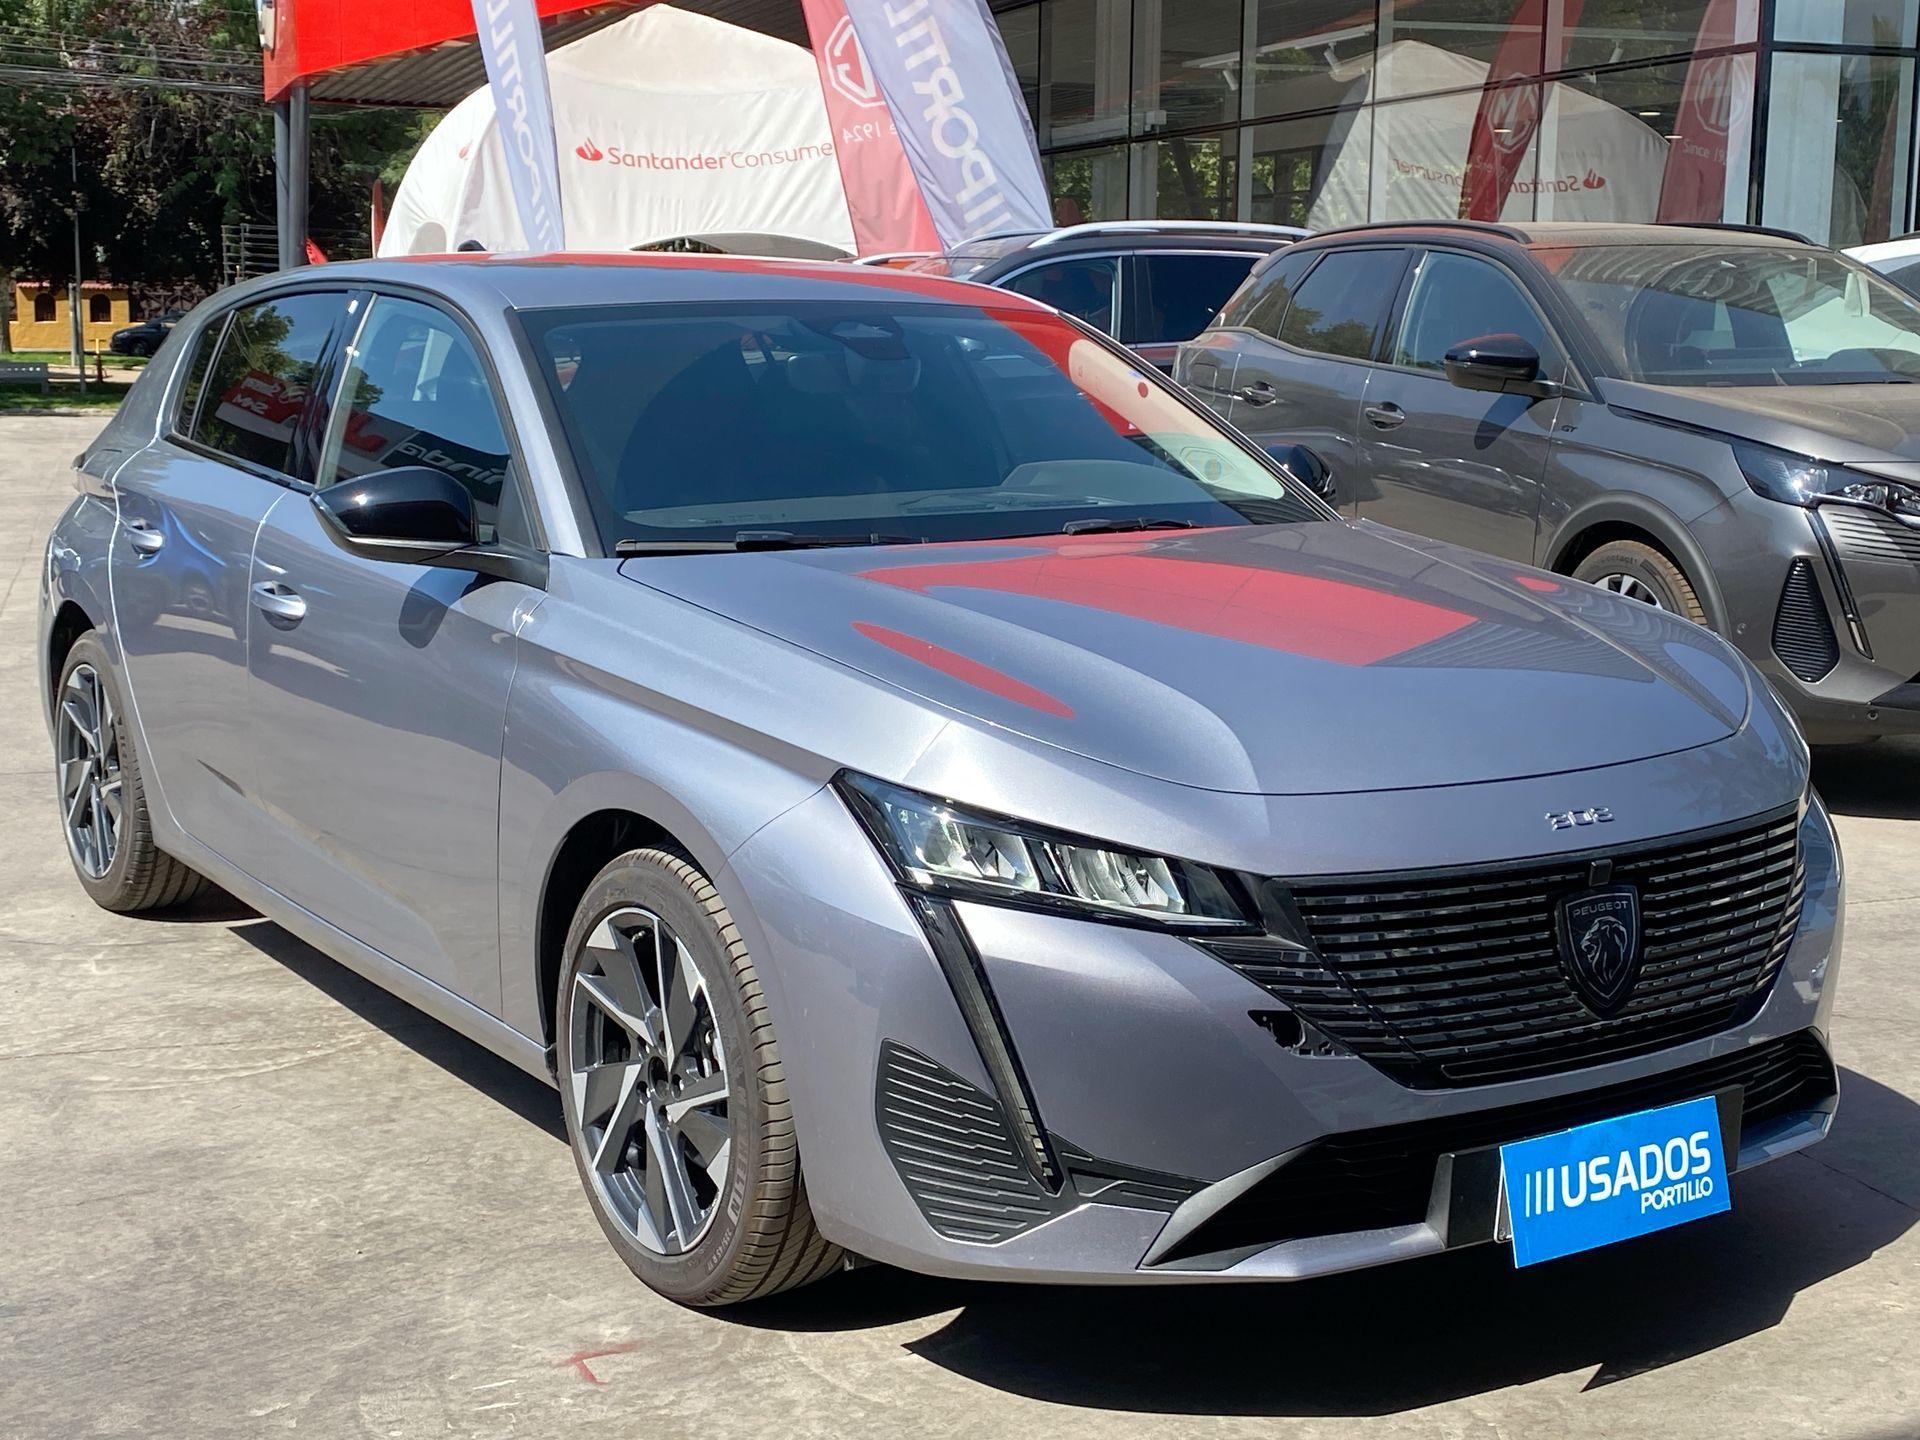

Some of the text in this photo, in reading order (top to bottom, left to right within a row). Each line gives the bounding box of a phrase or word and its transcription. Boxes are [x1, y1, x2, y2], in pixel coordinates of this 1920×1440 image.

[608, 142, 833, 170] Santander Consume
[1573, 901, 1629, 918] PEUGEOT
[1561, 1130, 1712, 1208] USADOS
[1640, 1176, 1714, 1214] PORTILLO
